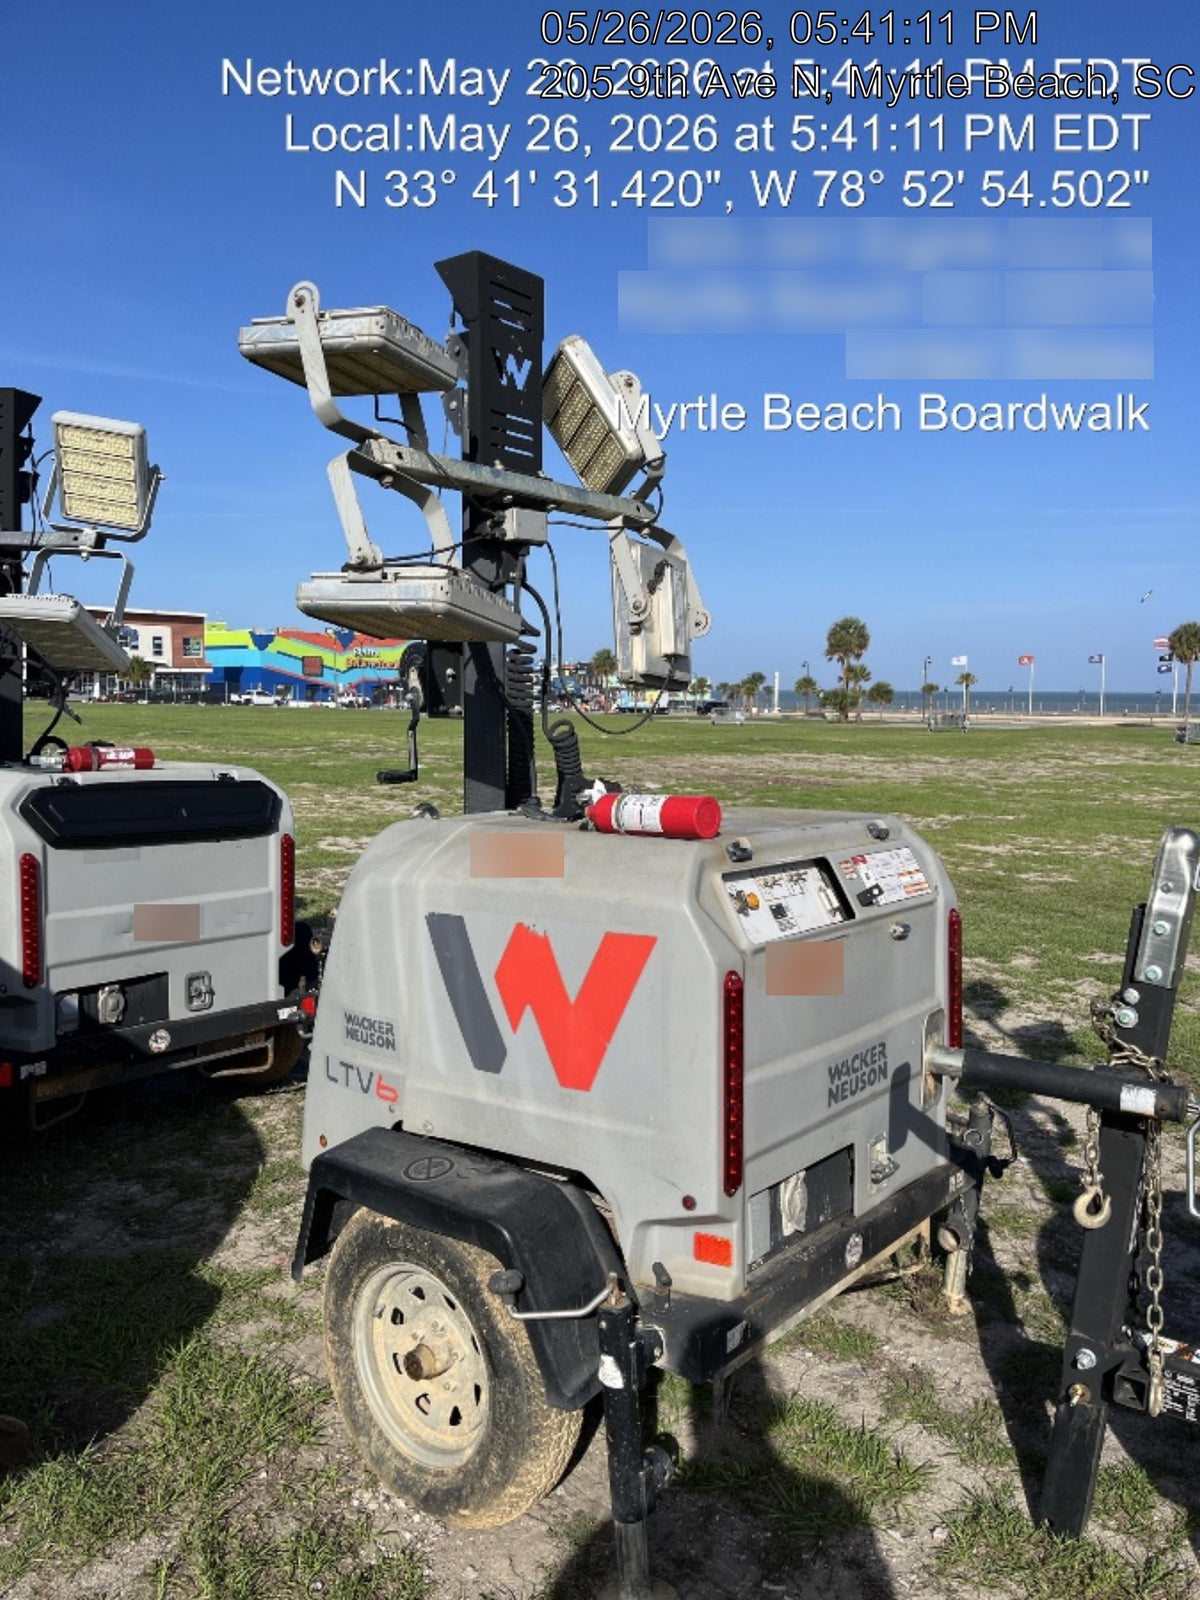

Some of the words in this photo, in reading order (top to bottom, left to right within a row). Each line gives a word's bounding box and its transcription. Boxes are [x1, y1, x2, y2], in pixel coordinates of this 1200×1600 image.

[344, 1011, 396, 1037] WACKER
[345, 1026, 397, 1052] NEUSON
[325, 1055, 400, 1104] LTV6
[827, 1041, 888, 1085] WACKER
[827, 1061, 888, 1109] NEUSON
